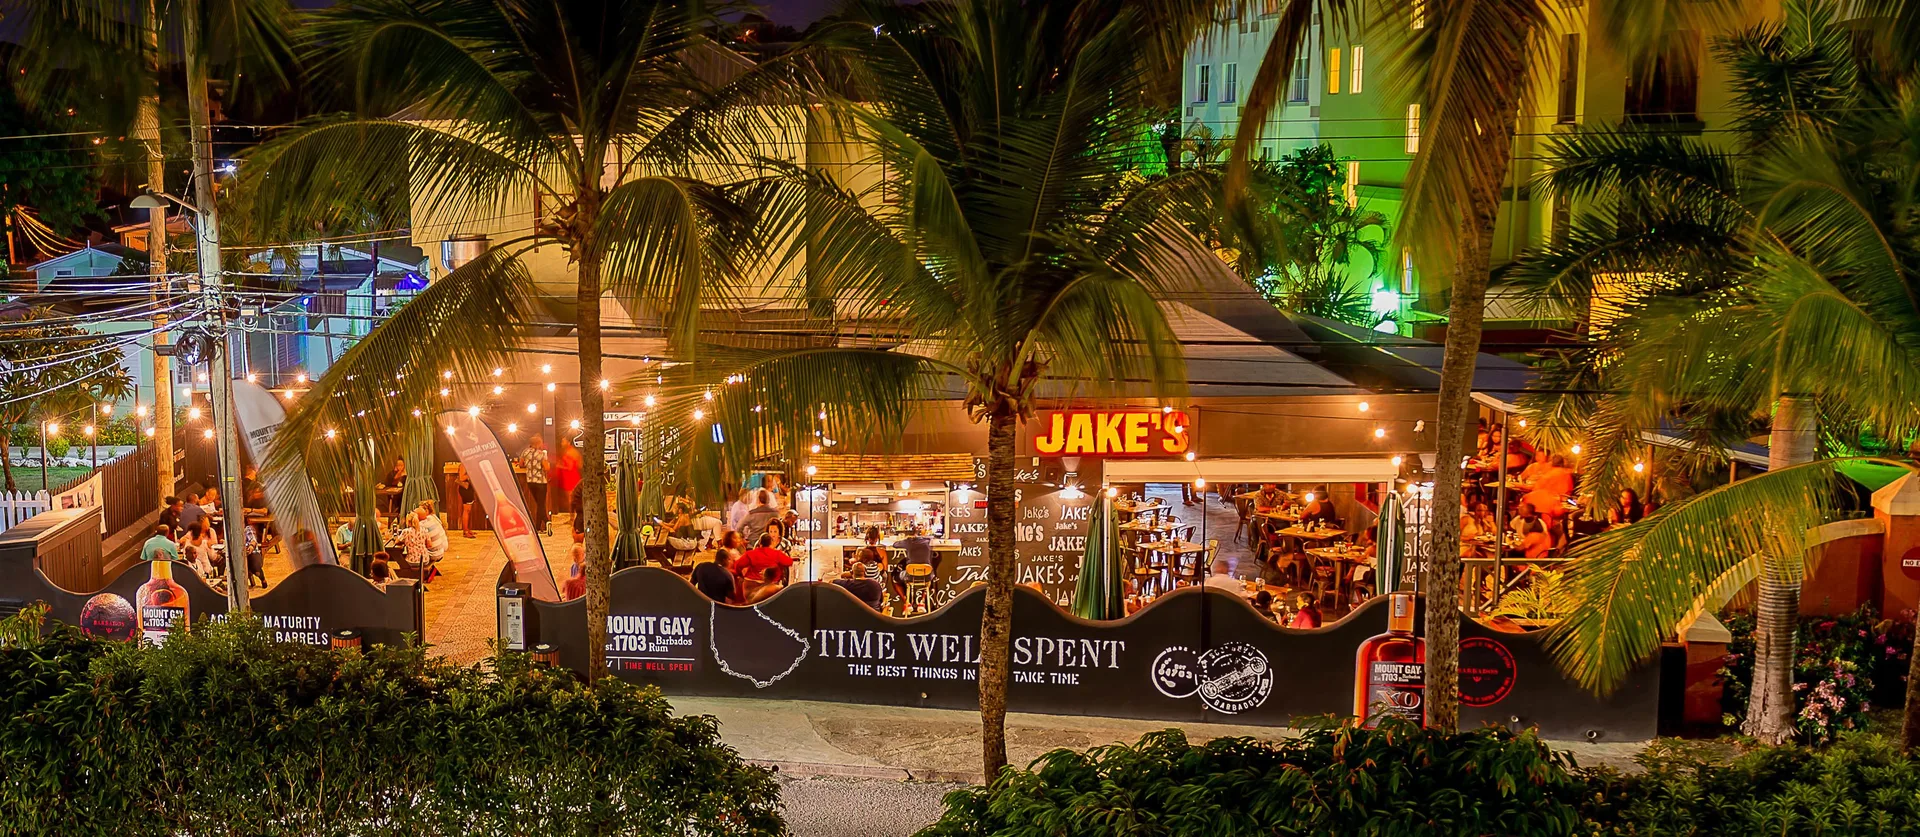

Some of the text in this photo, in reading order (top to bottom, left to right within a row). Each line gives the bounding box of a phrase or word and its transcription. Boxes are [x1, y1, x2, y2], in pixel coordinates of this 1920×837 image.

[1036, 412, 1190, 453] JAKE'S
[1023, 506, 1050, 519] Jake's
[953, 523, 988, 533] JAKE'
[1014, 522, 1044, 542] ke's
[1055, 522, 1078, 531] Jake's
[1048, 536, 1087, 551] JAKE'
[949, 565, 989, 584] Jak
[1015, 563, 1065, 584] JAKE'S
[143, 608, 169, 619] MOUNT
[149, 619, 165, 627] 1703
[263, 615, 321, 630] MATURITY
[275, 631, 329, 645] BARRELS
[613, 635, 647, 651] 1703
[656, 636, 693, 646] Barbados
[649, 642, 669, 653] Rum
[813, 629, 1126, 669] TIME WEL SPENT
[624, 661, 693, 672] TIME WELL SPENT
[1374, 664, 1404, 674] MOUNT
[847, 664, 1080, 685] THE BEST THINGS IN TAKE TIME
[1381, 673, 1398, 682] 1703
[1213, 697, 1259, 711] BARBADOS
[1376, 688, 1421, 710] XO
